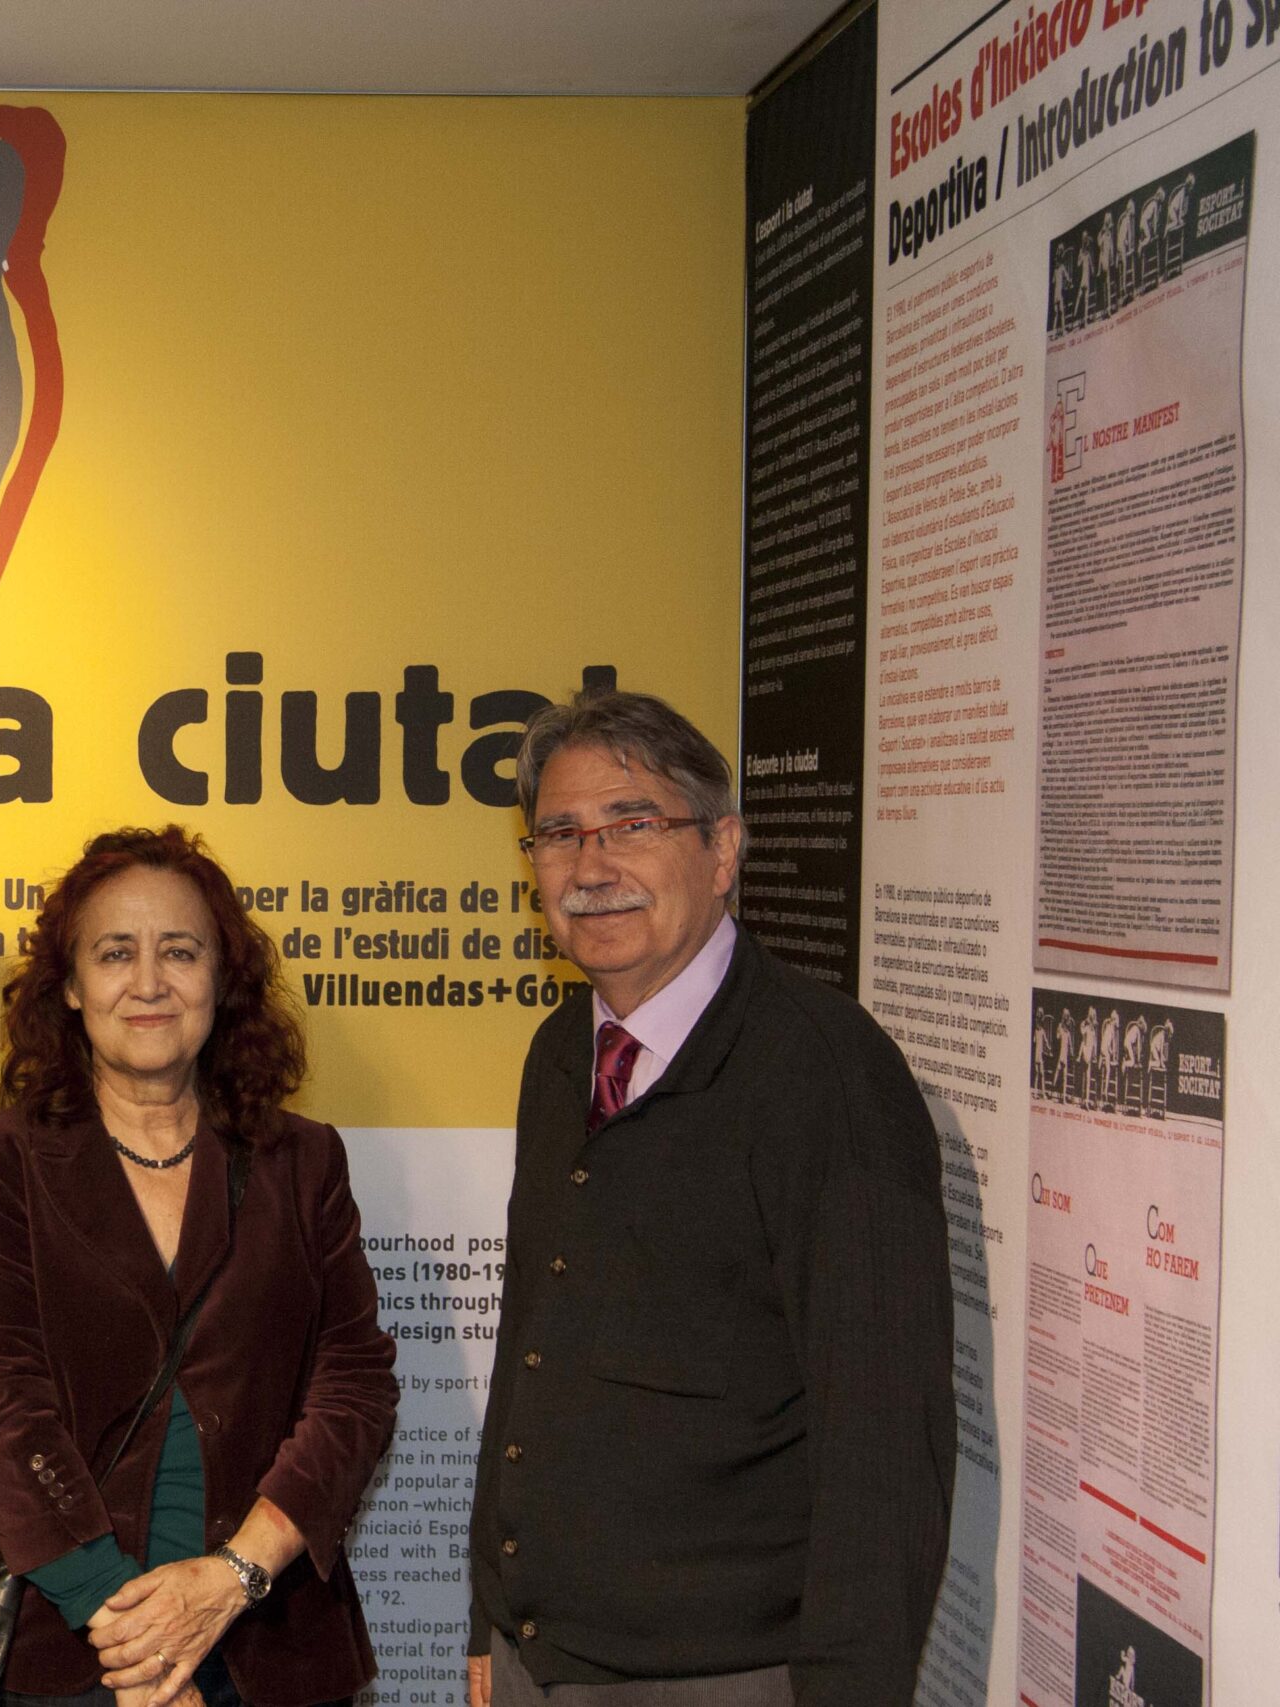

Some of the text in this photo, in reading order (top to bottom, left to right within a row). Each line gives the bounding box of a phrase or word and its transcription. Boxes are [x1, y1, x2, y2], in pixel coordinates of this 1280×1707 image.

[888, 154, 988, 266] Deportiva
[1017, 25, 1187, 188] Introduction
[1199, 0, 1234, 76] to
[889, 78, 963, 179] Escoles
[1092, 421, 1129, 450] NOSTRE
[1132, 401, 1180, 437] MANIFEST
[138, 651, 618, 806] ciuta
[4, 878, 44, 910] Un
[235, 886, 289, 912] per
[302, 880, 329, 913] la
[341, 877, 447, 917] gràfica
[460, 881, 499, 913] de
[282, 927, 570, 960] de l'estudi de dis
[1178, 1075, 1221, 1099] SOCIETAT
[1052, 1190, 1071, 1214] SOM
[468, 1238, 507, 1256] pos
[1146, 1246, 1199, 1281] HO FAREM
[421, 1293, 502, 1314] through
[1084, 1282, 1129, 1317] PRETENEM
[387, 1321, 456, 1343] design
[412, 1375, 430, 1393] by
[435, 1376, 479, 1393] sport
[454, 1427, 471, 1441] of
[421, 1450, 435, 1465] in
[374, 1473, 390, 1488] of
[394, 1473, 460, 1492] popular
[401, 1543, 436, 1559] with
[394, 1567, 461, 1582] reached
[430, 1642, 454, 1657] for
[376, 1665, 457, 1683] ropolitan
[409, 1690, 437, 1704] out
[445, 1692, 459, 1704] a
